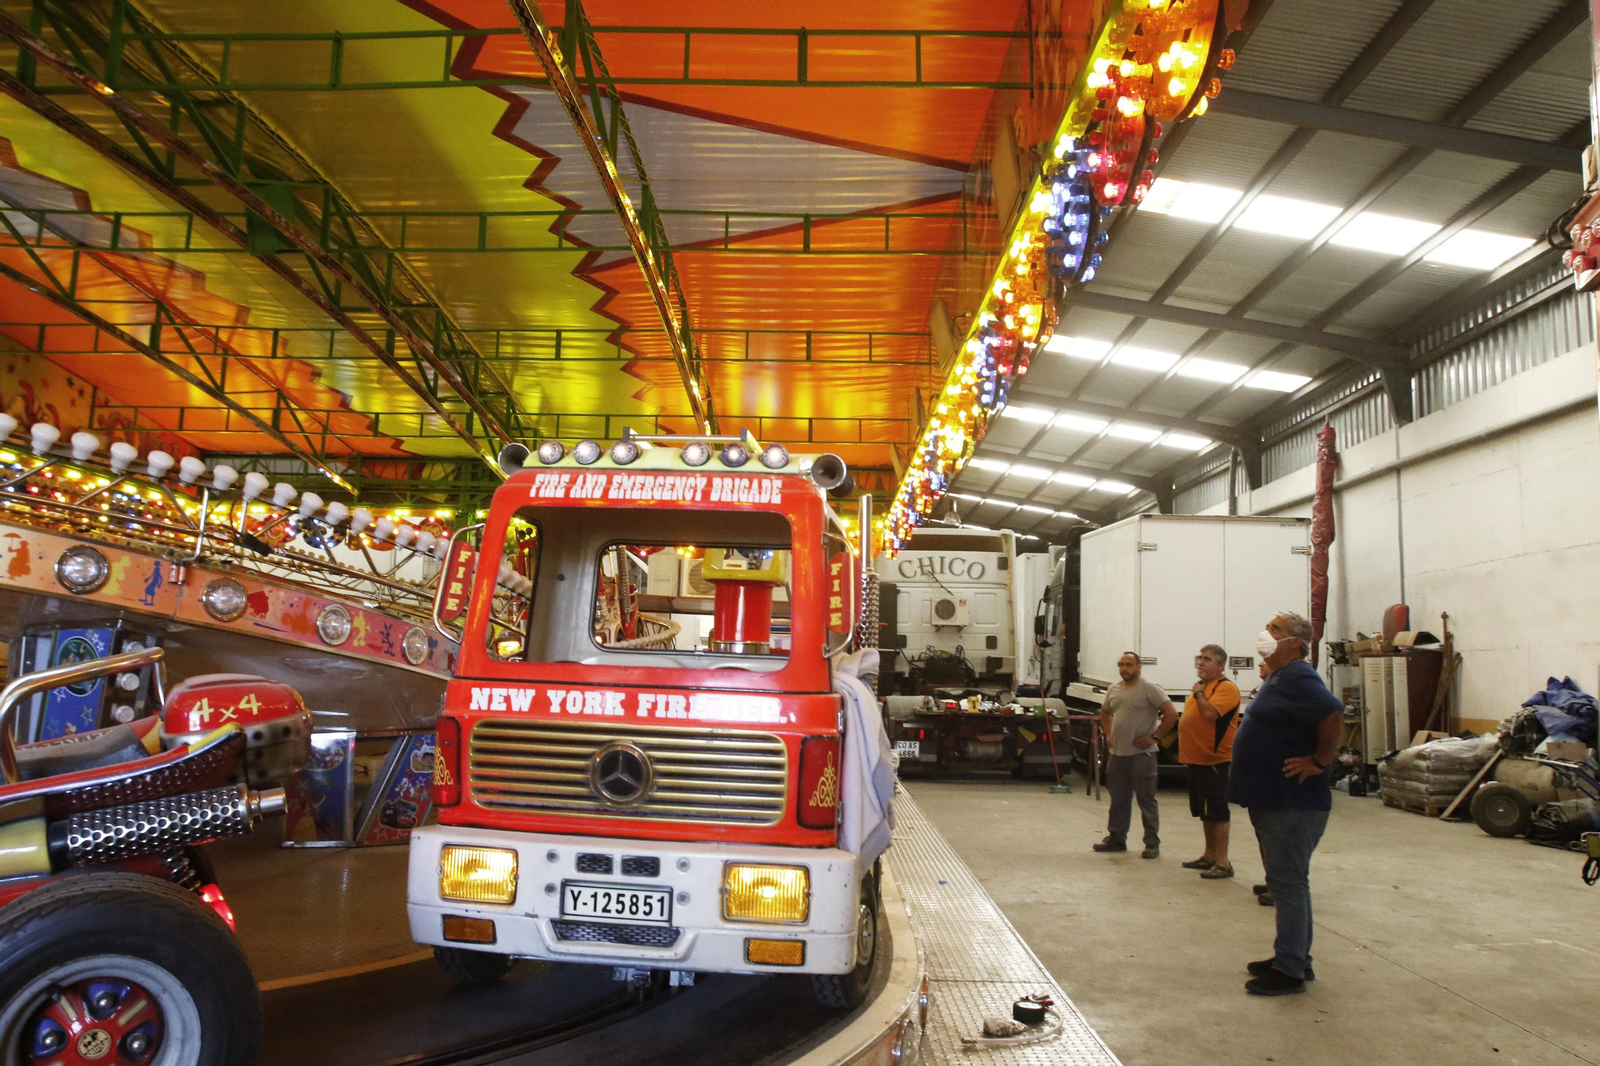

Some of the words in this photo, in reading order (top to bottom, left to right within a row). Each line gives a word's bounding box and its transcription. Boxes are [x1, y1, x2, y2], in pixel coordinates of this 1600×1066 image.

[529, 473, 571, 498] FIRE
[569, 473, 608, 499] AND
[608, 474, 708, 501] EMERGENCY
[710, 477, 783, 504] BRIGADE
[445, 550, 472, 611] FIRE
[897, 556, 986, 580] CHICO
[829, 562, 843, 626] FIRE
[469, 687, 536, 712] NEW
[546, 689, 626, 716] YORK
[636, 692, 706, 720] FIRE
[570, 888, 665, 917] Y-125851
